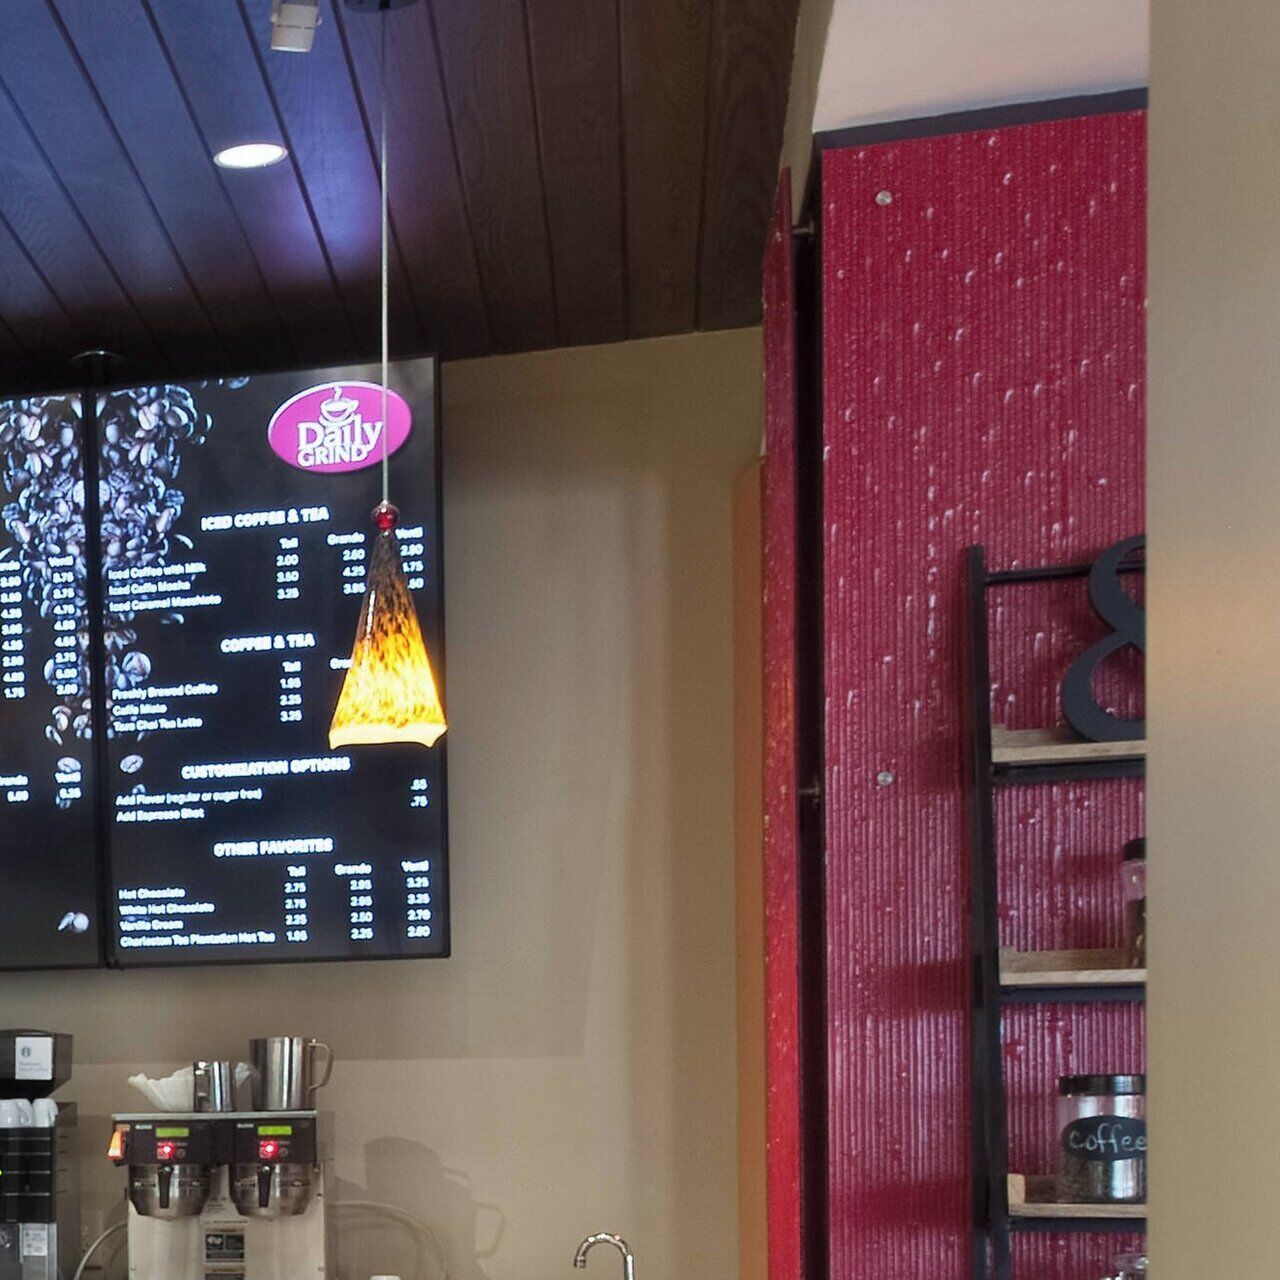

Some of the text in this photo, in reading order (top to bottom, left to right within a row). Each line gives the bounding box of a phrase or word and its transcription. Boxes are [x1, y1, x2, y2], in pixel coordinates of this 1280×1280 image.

[297, 413, 384, 451] Daily
[297, 446, 368, 467] GRIND
[201, 507, 329, 530] ICED COFFEE & TEA
[220, 633, 315, 652] COFFEE & TEA
[182, 757, 350, 779] CUSTOMIZATION OPTIONS
[214, 838, 333, 857] OTHER FAVORITES
